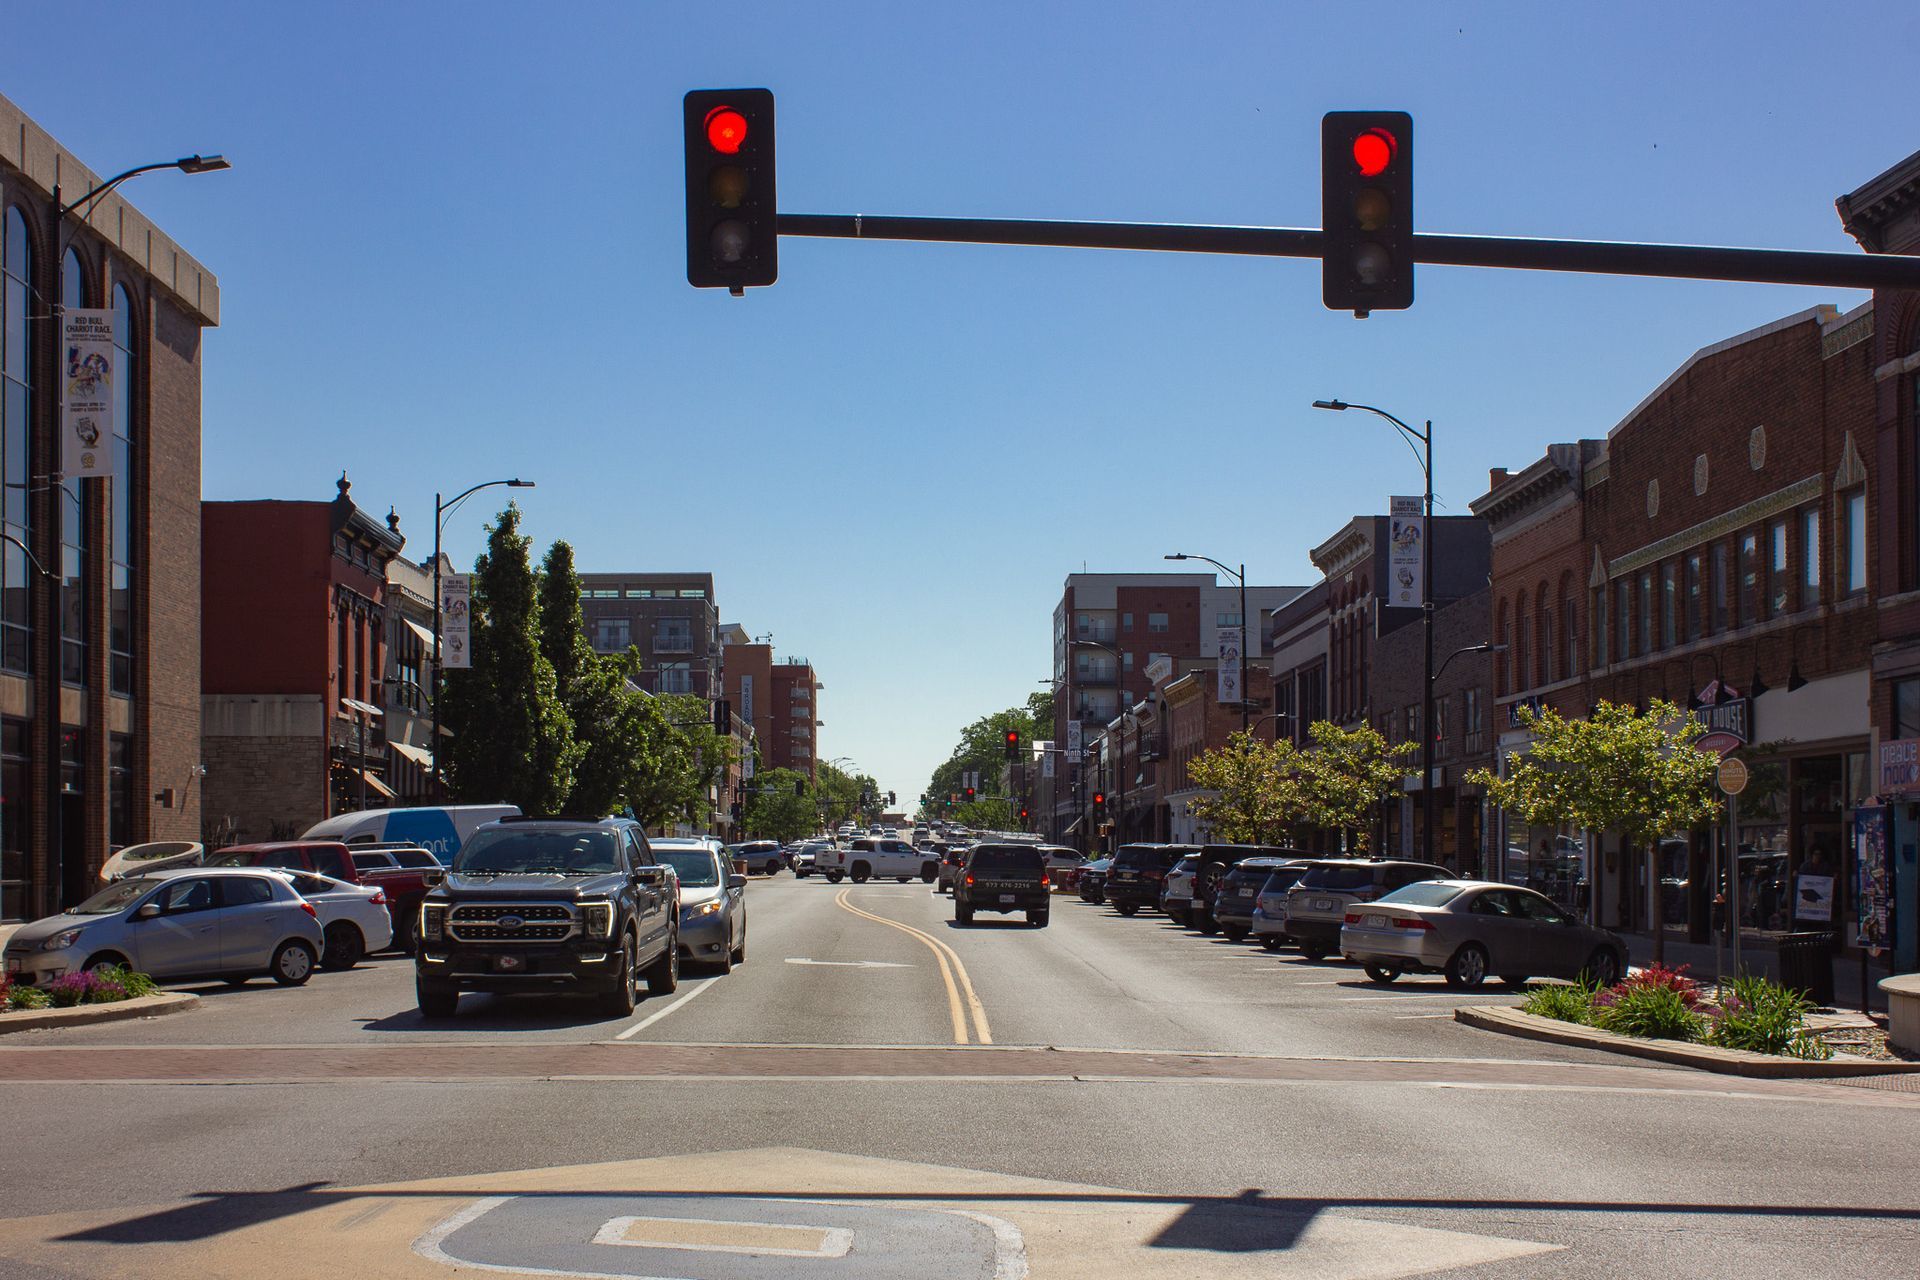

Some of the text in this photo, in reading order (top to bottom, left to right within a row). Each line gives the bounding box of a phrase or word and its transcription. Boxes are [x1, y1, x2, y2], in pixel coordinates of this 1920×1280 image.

[75, 316, 103, 325] RED BULL
[66, 325, 92, 333] CHARIOT
[1713, 704, 1744, 736] HOUSE
[1063, 749, 1090, 757] Ninth St
[1881, 743, 1918, 764] peace
[1882, 765, 1910, 785] nook
